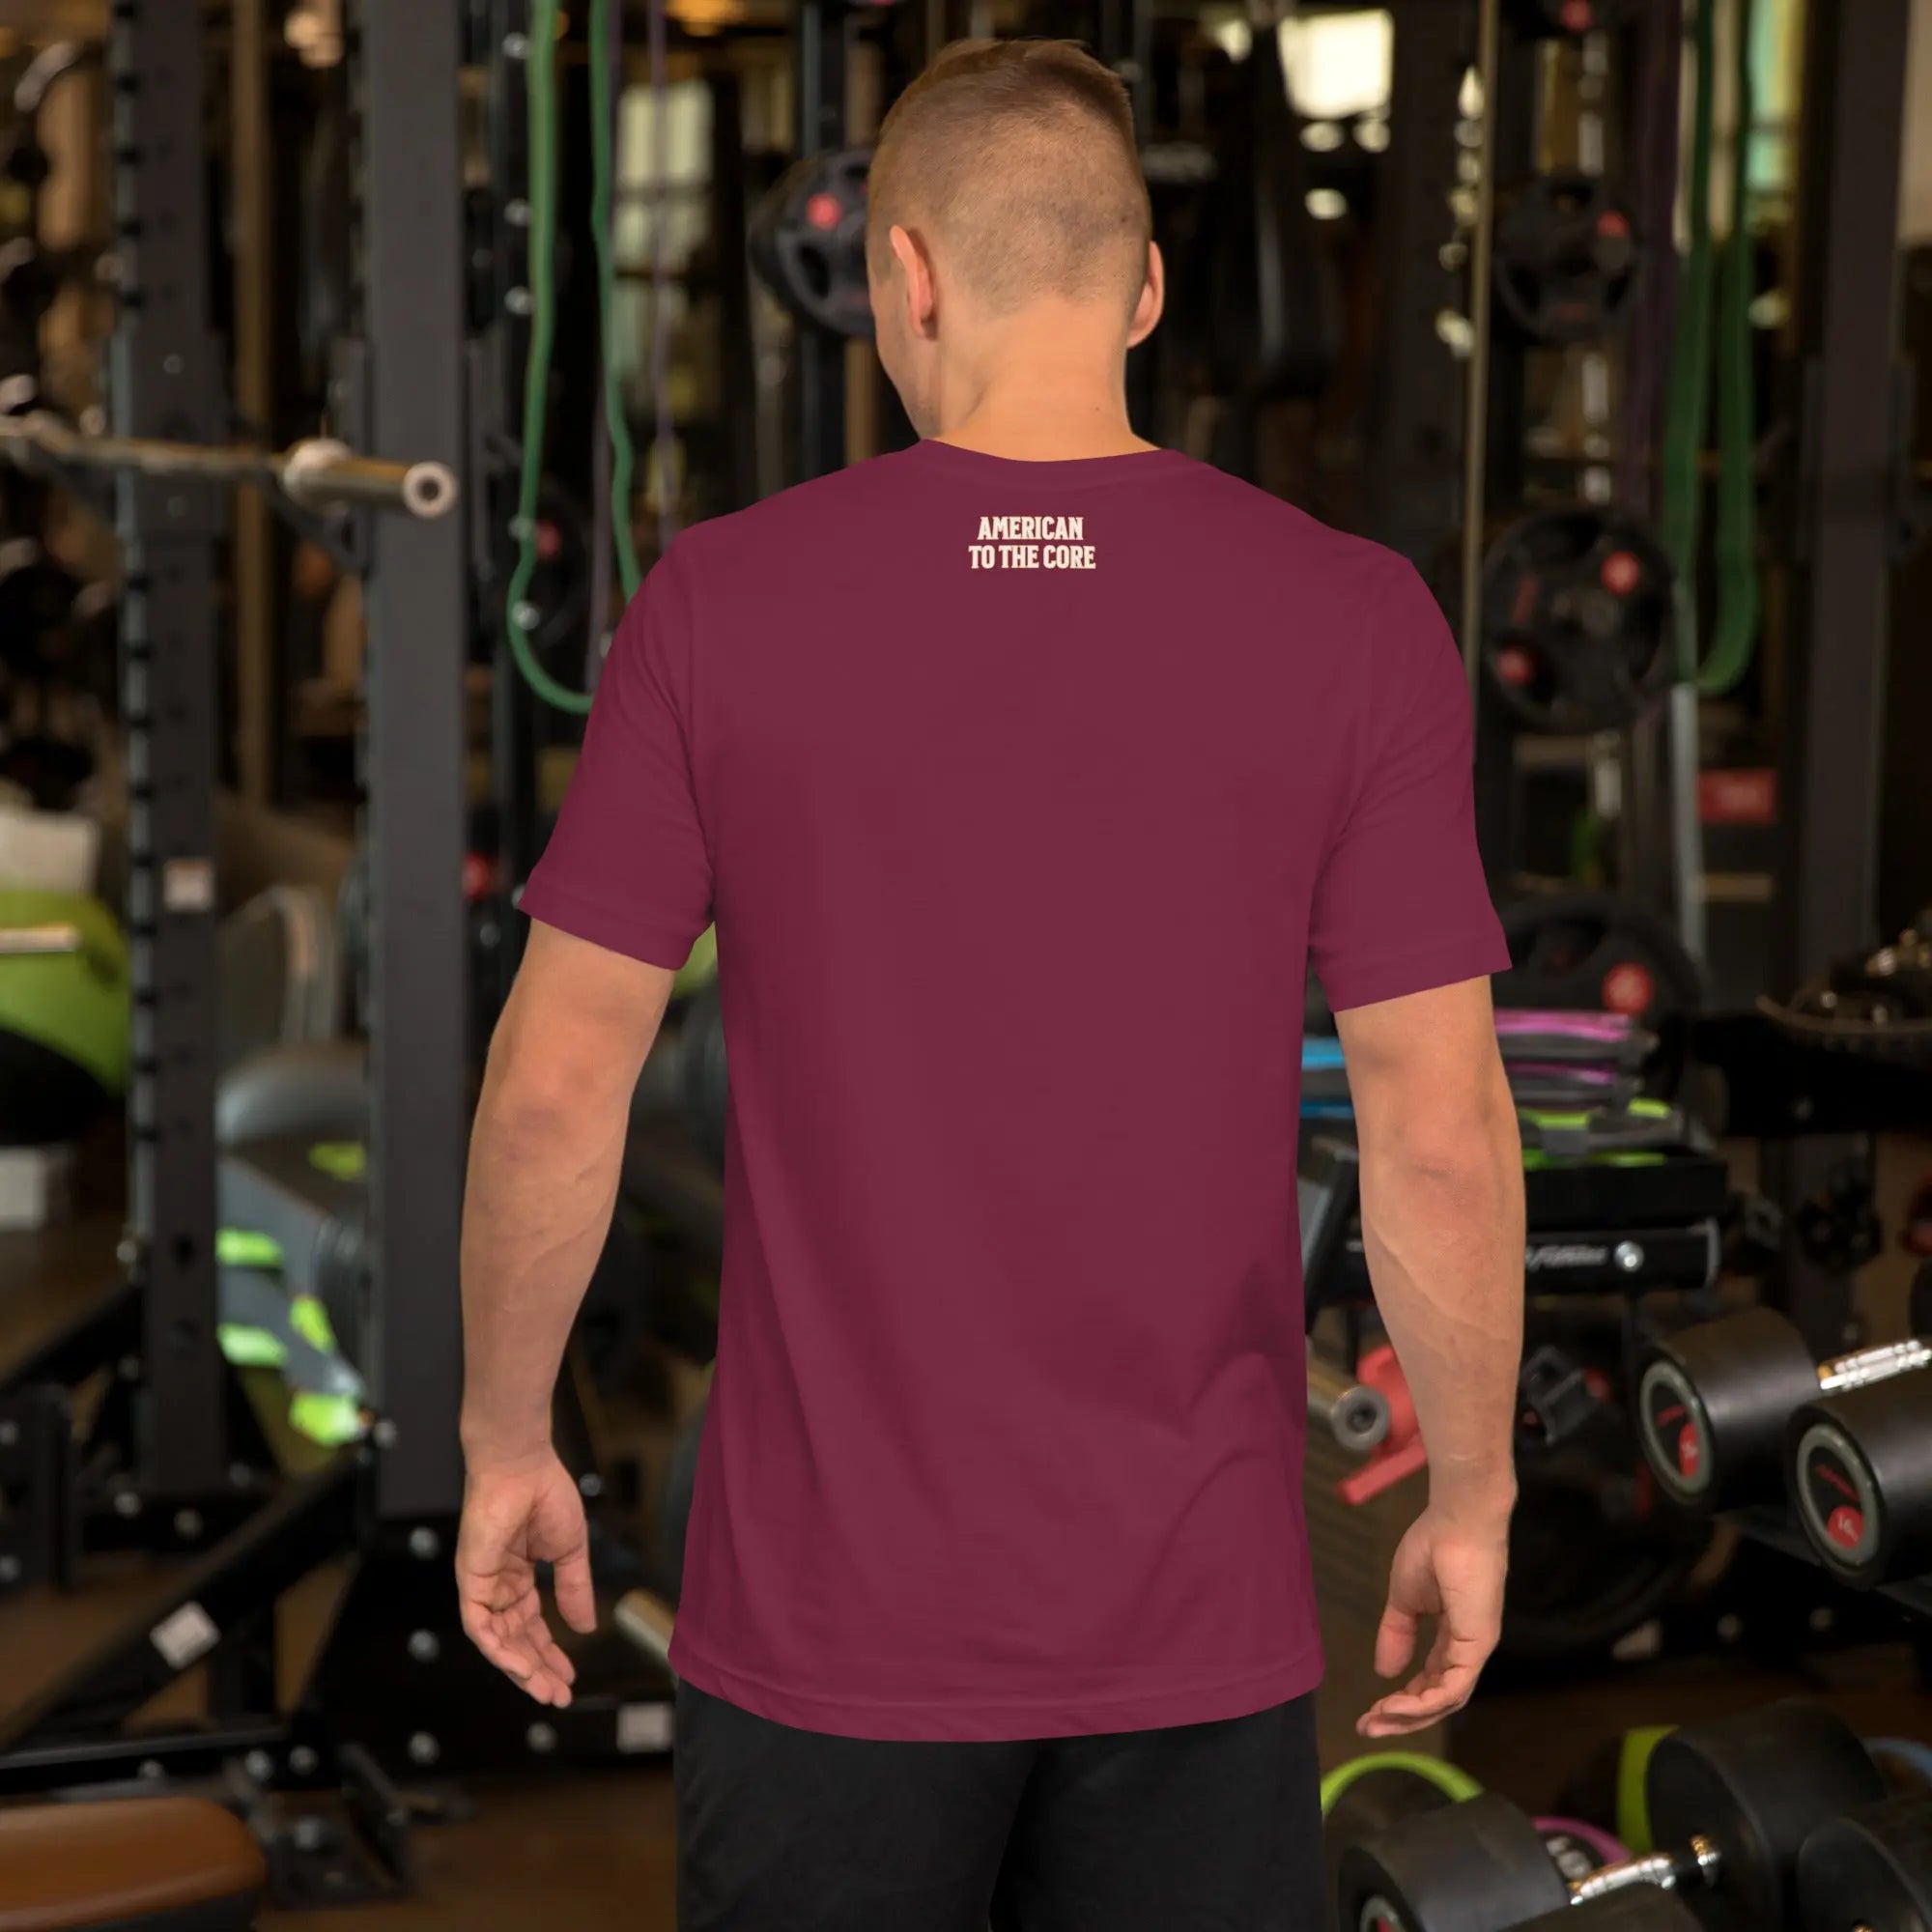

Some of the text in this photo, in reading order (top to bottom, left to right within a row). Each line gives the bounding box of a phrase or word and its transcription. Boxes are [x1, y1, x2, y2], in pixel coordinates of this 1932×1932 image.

[977, 516, 1084, 541] AMERICAN
[968, 544, 1096, 570] TO THE CORE
